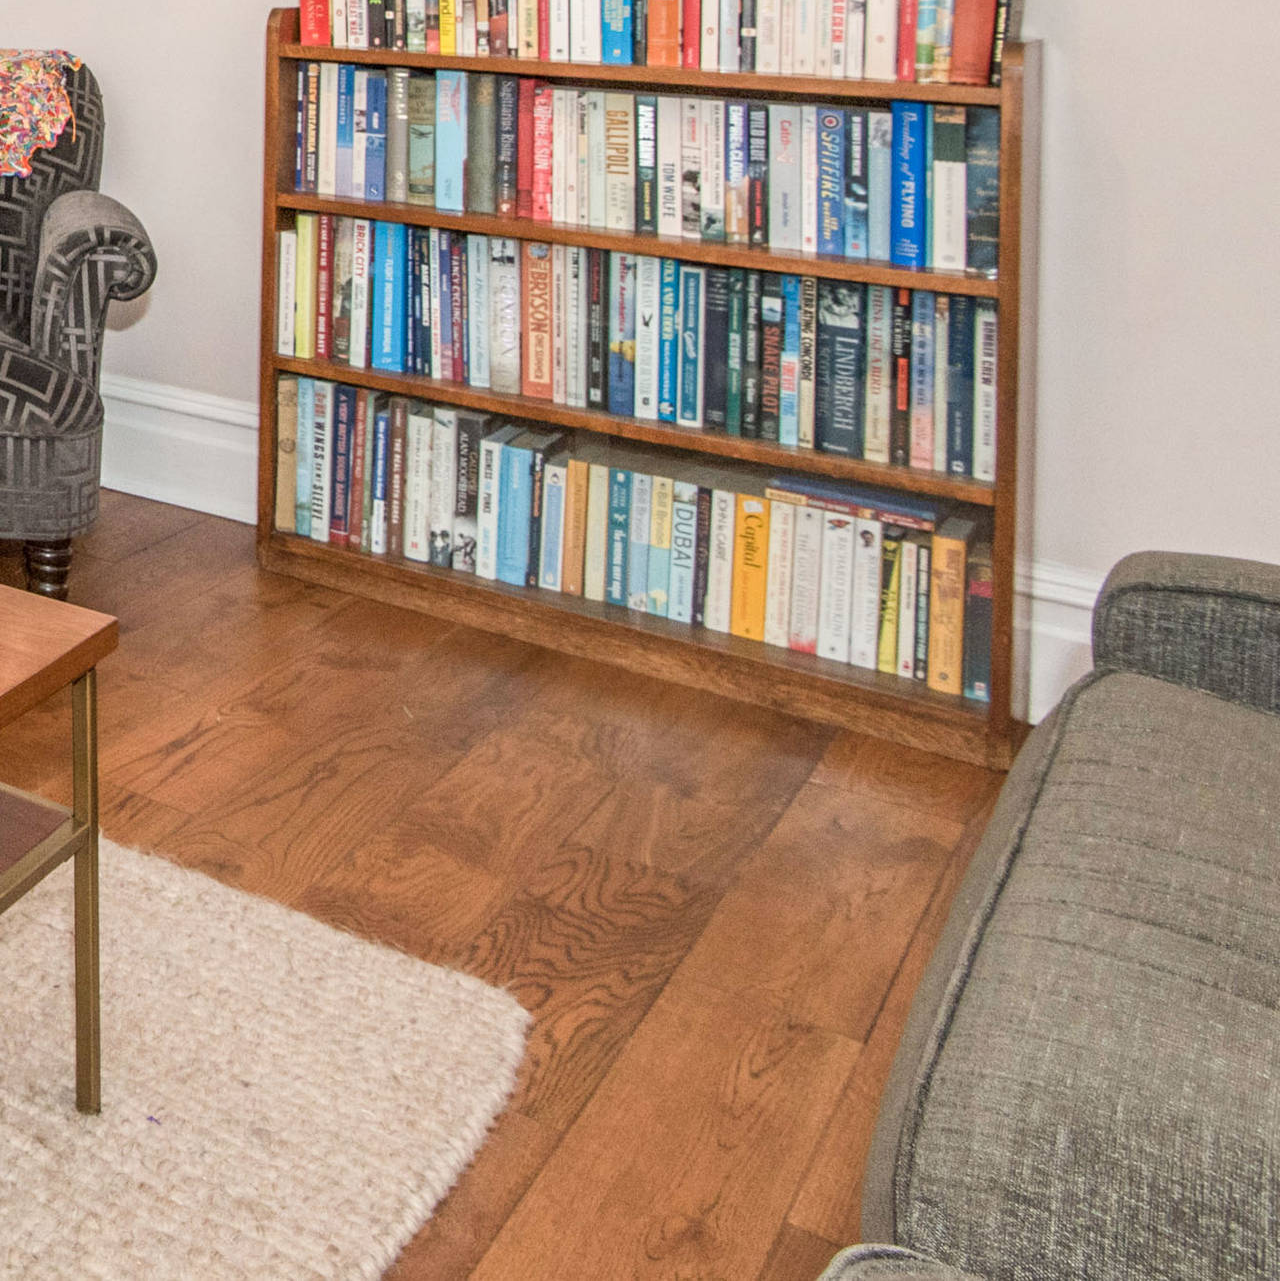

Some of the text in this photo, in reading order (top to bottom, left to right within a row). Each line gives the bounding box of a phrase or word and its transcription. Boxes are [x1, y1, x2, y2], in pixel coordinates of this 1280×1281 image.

[833, 5, 844, 14] OF
[499, 80, 515, 162] Sagittarius Rising
[534, 98, 552, 170] EMPIRE SUN
[605, 110, 629, 175] GALLIPOLI
[638, 105, 655, 167] APACHE DAWN
[729, 106, 742, 145] EMPIRE
[749, 110, 766, 161] WILD BLUE
[663, 162, 675, 218] TOM WOLFE
[821, 132, 840, 201] SPITFIRE
[901, 180, 915, 228] FLYING
[356, 224, 365, 254] BRICK
[571, 252, 580, 279] TINTIN
[356, 256, 364, 278] CITY
[619, 256, 627, 332] Better Aerobatics
[452, 286, 460, 322] CYCLING
[500, 274, 516, 355] LONDON
[530, 271, 548, 333] BRYSON
[662, 305, 674, 340] RUDDER
[872, 288, 883, 323] THINK
[800, 279, 815, 382] CELEBRATING CONCORDE
[872, 326, 882, 352] LIKE
[982, 321, 996, 386] BOMBER CREW
[764, 327, 779, 416] SNAKE PILOT
[782, 361, 796, 392] FOREVER
[833, 336, 859, 430] LINDBERGH
[871, 366, 882, 395] BIRD
[339, 402, 347, 423] VERY
[314, 422, 325, 460] WINGS
[392, 438, 401, 524] THE REAL NORTH KOREA
[457, 431, 469, 513] ALAN MOOREHEAD
[483, 449, 493, 513] BUSINESS PUNKS
[312, 484, 323, 520] SLEEVE
[718, 497, 727, 523] JOHN
[673, 508, 694, 570] DUBAI
[739, 515, 764, 569] Capital
